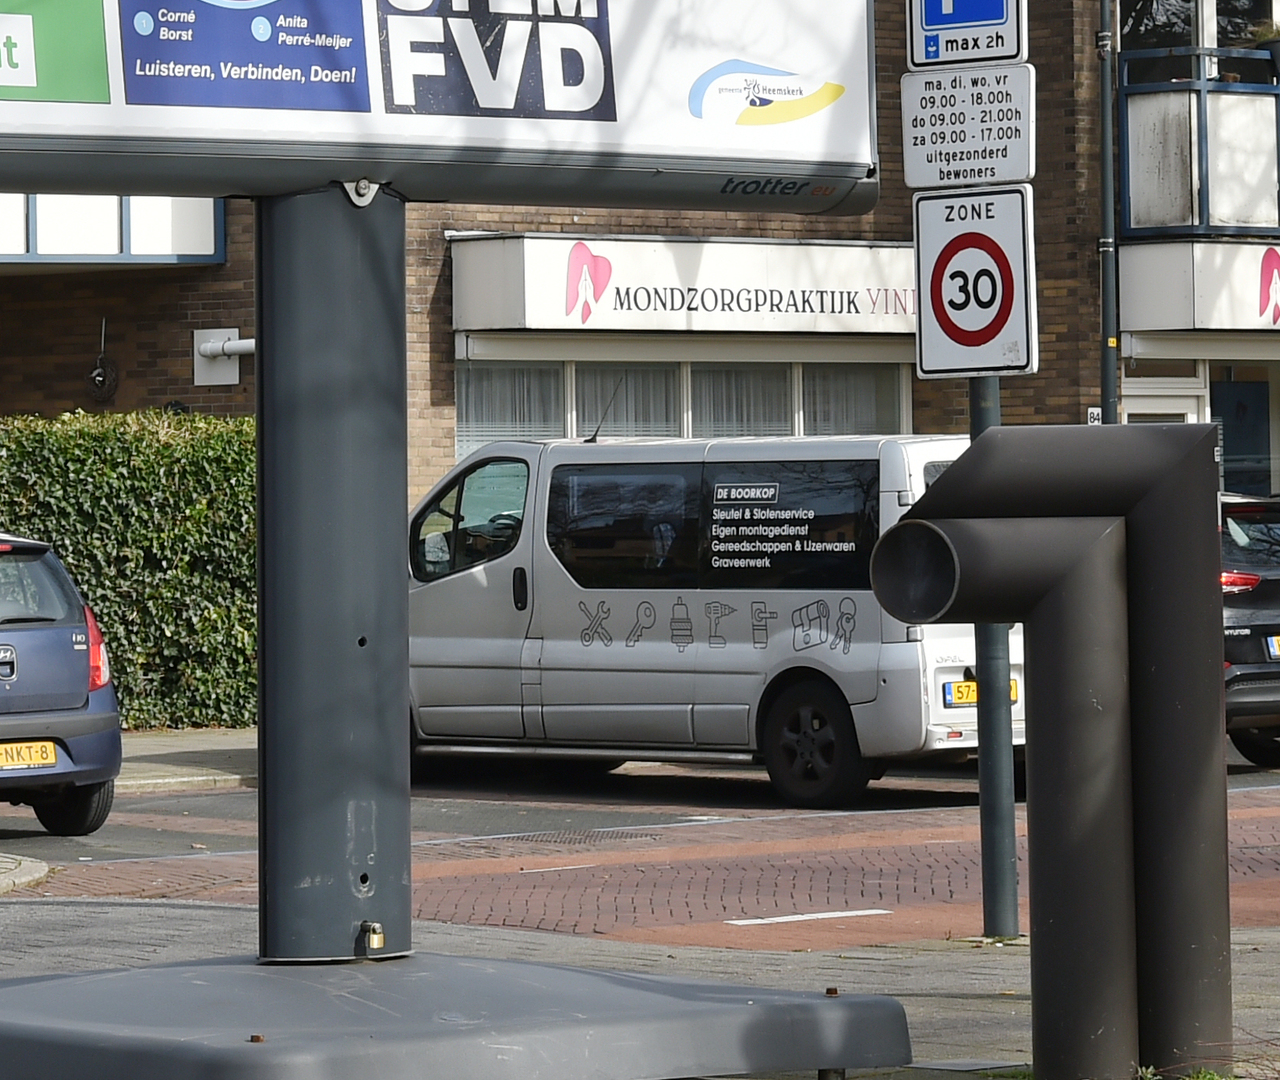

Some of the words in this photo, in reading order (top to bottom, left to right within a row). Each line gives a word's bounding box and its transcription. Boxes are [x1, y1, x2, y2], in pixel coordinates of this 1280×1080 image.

[158, 9, 196, 24] Corné
[258, 25, 264, 34] 2
[276, 14, 308, 29] Anita
[159, 27, 193, 41] Borst
[278, 33, 353, 50] Perré-Meijer
[945, 35, 980, 52] max
[985, 31, 1005, 49] 2h
[135, 58, 216, 81] Luisteren,
[220, 61, 306, 84] Verbinden,
[309, 66, 357, 83] Doen!
[386, 15, 605, 113] FVD
[762, 86, 804, 97] Heemskerk
[924, 79, 946, 93] ma,
[950, 76, 967, 91] di,
[970, 76, 991, 90] wo,
[995, 74, 1009, 87] vr
[919, 94, 957, 110] 09.00
[970, 92, 1012, 106] 18.00h
[911, 114, 926, 129] do
[929, 112, 967, 127] 09.00
[980, 108, 1022, 124] 21.00h
[912, 133, 926, 147] za
[929, 129, 967, 145] 09.00
[980, 126, 1021, 142] 17.00h
[926, 144, 1009, 166] uitgezonderd
[938, 165, 997, 182] bewoners
[944, 202, 996, 223] ZONE
[947, 268, 998, 311] 30
[613, 286, 861, 315] MONDZORGPRAKTIJK
[866, 288, 917, 315] YIN
[1089, 411, 1101, 424] 84
[717, 488, 728, 499] DE
[731, 487, 776, 499] BOORKOP
[712, 508, 742, 520] Sleutel
[744, 508, 752, 520] &
[752, 507, 815, 520] Slotenservice
[712, 524, 737, 538] Eigen
[738, 523, 809, 538] montagedienst
[711, 540, 793, 554] Gereedschappen
[794, 540, 802, 552] &
[804, 540, 856, 552] IJzerwaren
[711, 556, 771, 568] Graveerwerk
